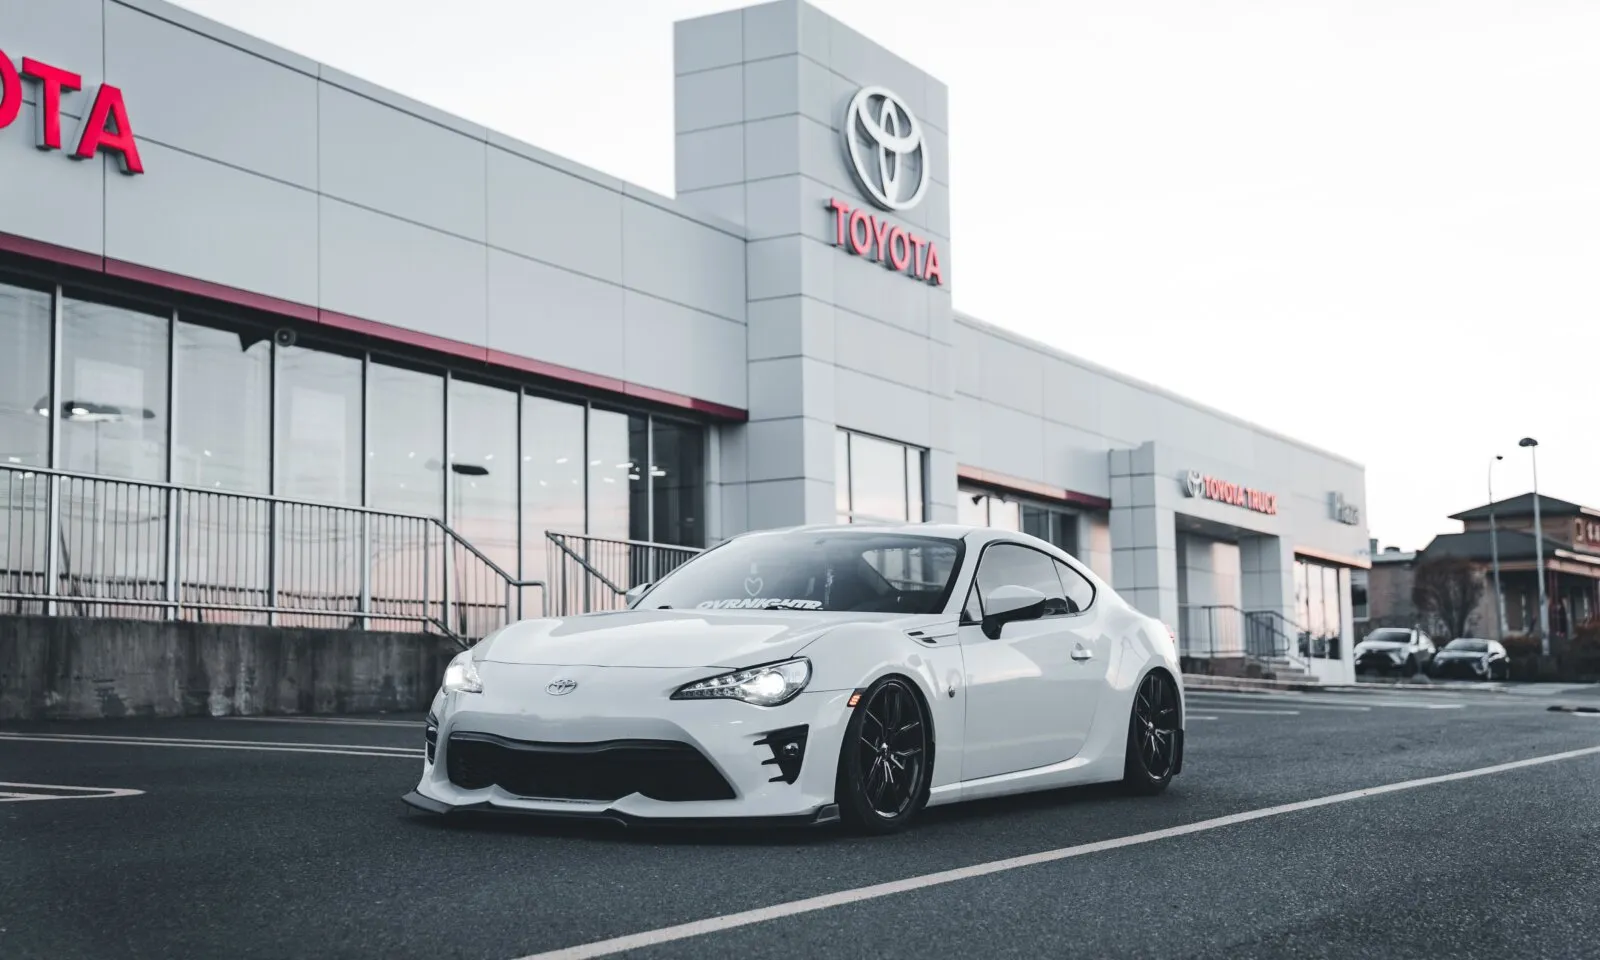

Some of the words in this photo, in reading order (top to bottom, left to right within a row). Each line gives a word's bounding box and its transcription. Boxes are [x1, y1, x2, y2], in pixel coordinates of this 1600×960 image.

[828, 197, 943, 286] TOYOTA
[1203, 475, 1245, 507] TOYOTA
[1245, 486, 1278, 515] TRUCK
